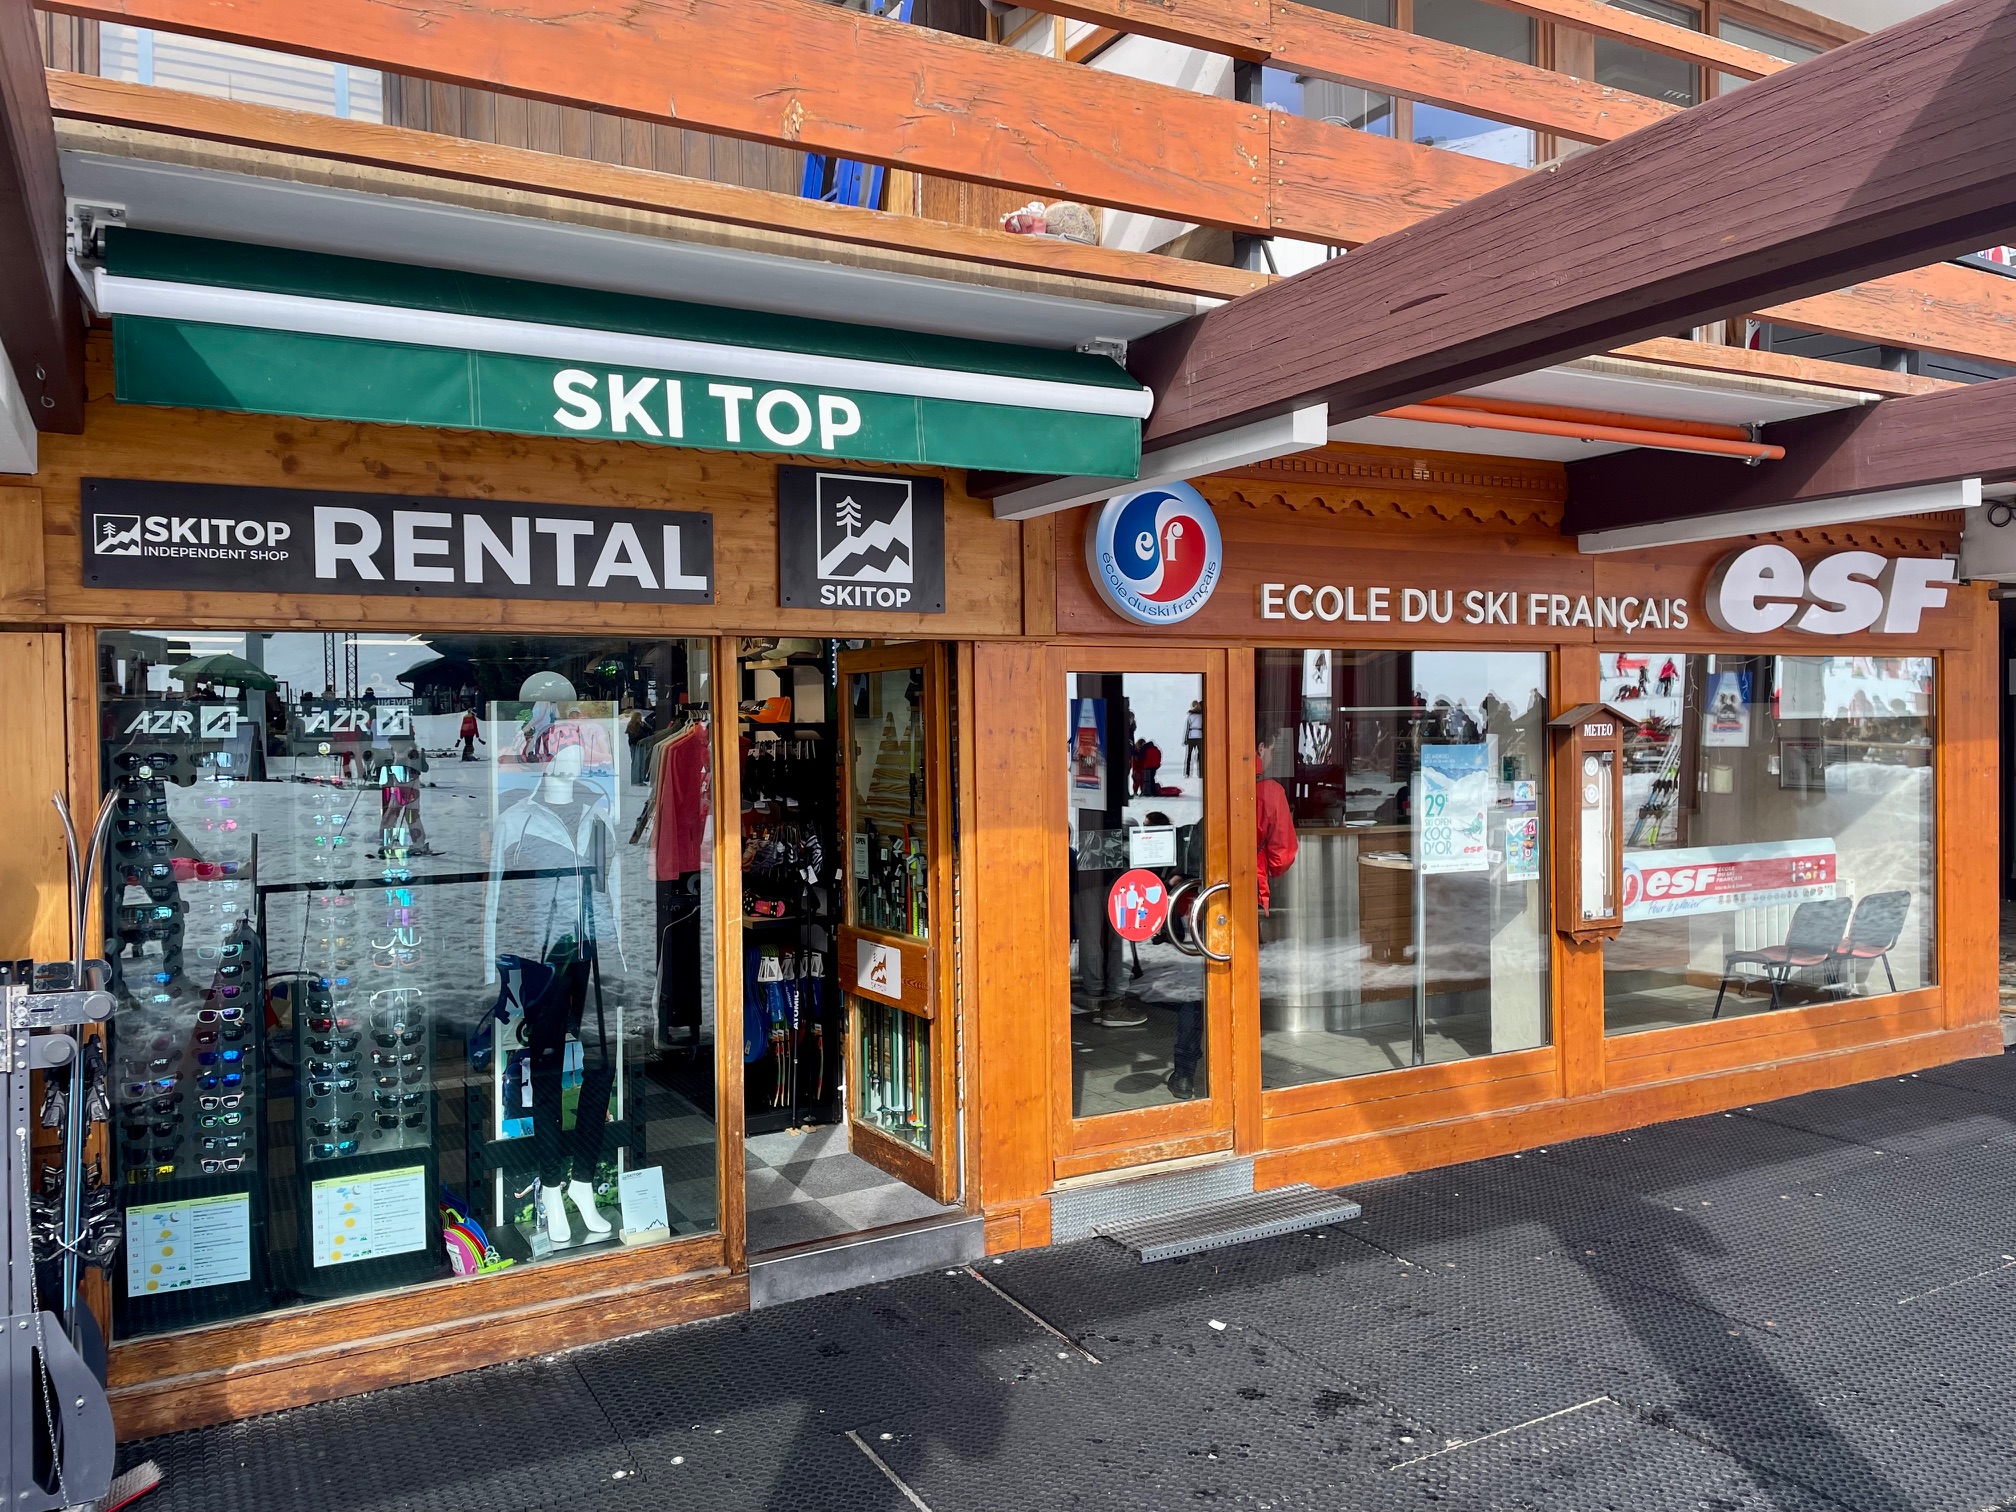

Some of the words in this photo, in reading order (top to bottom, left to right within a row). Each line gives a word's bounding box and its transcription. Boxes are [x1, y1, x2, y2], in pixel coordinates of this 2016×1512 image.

[553, 369, 683, 438] SKI
[708, 383, 861, 450] TOP
[144, 516, 291, 546] SKITOP
[144, 546, 246, 560] INDEPENDENT
[250, 550, 289, 561] SHOP
[313, 506, 707, 590] RENTAL
[1103, 552, 1127, 598] école
[1173, 561, 1216, 615] français
[820, 585, 911, 608] SKITOP
[1261, 583, 1391, 622] ECOLE
[1401, 588, 1454, 624] DU
[1463, 590, 1518, 625] SKI
[1527, 593, 1689, 634] FRANÇAIS
[123, 710, 194, 734] AZR
[305, 709, 370, 733] AZR
[1584, 723, 1613, 736] METEO
[1424, 827, 1452, 841] COQ
[1425, 818, 1433, 827] SKI
[1434, 818, 1452, 826] OPEN
[1424, 841, 1452, 855] D'OR
